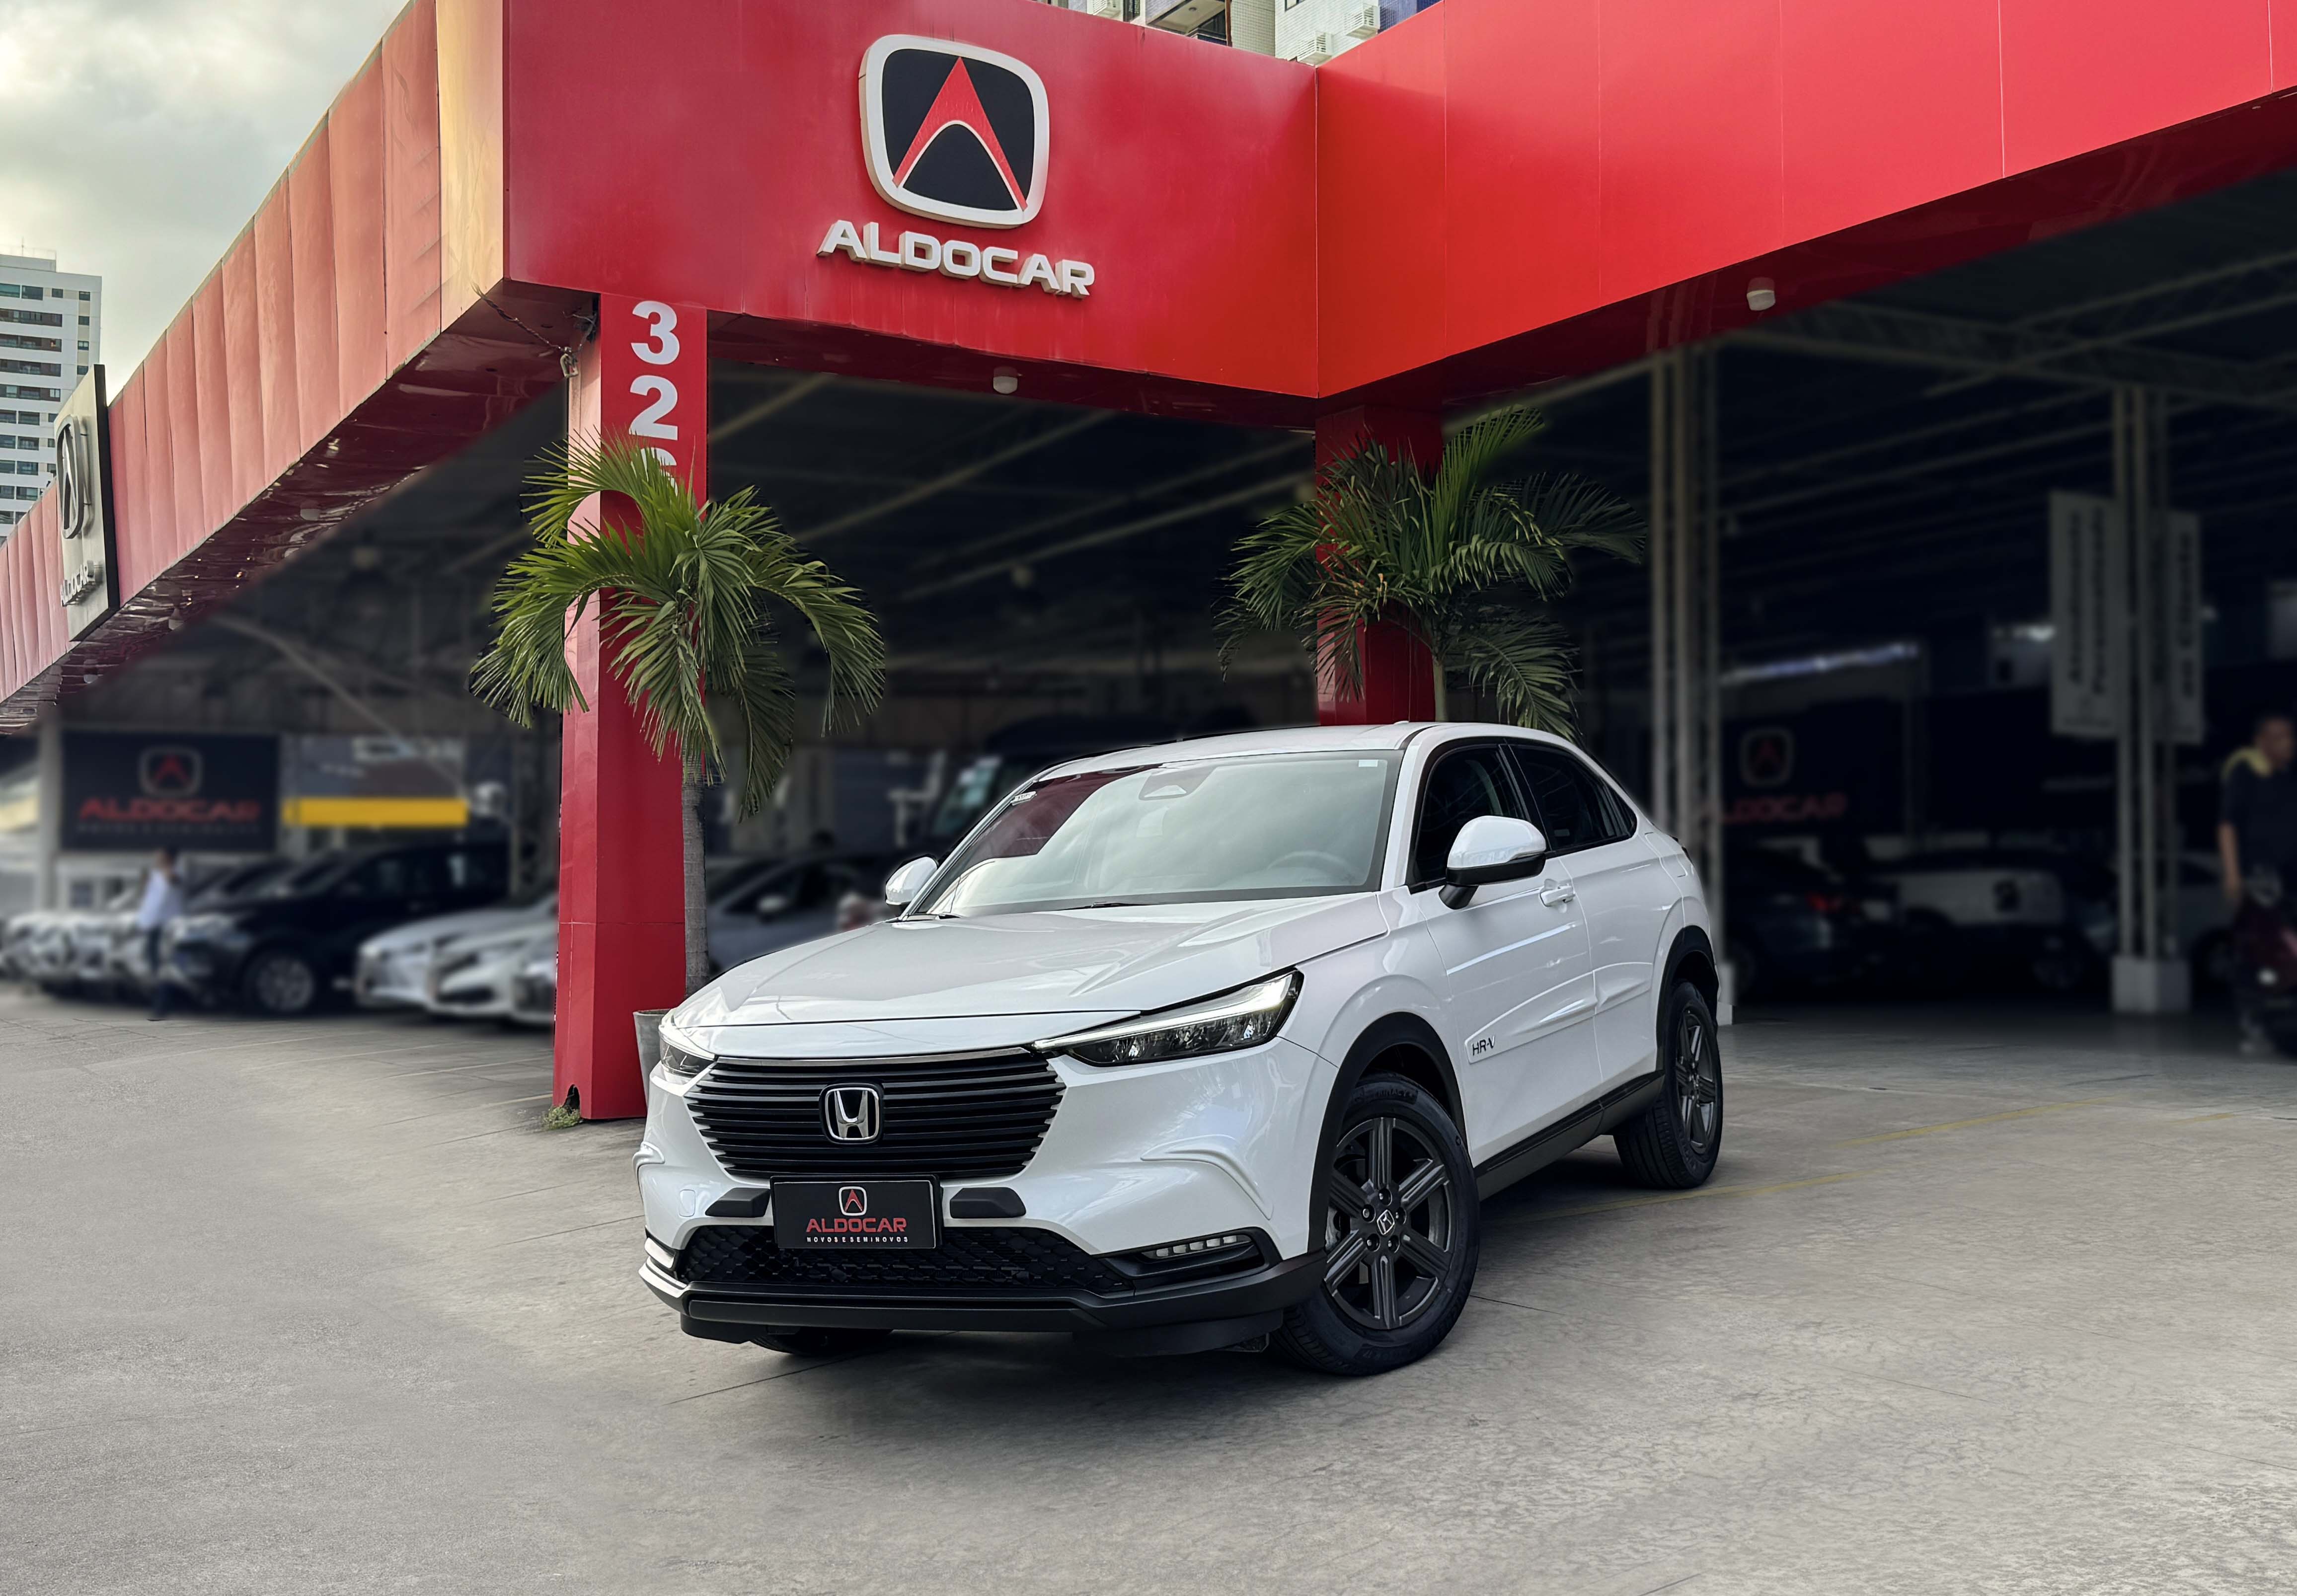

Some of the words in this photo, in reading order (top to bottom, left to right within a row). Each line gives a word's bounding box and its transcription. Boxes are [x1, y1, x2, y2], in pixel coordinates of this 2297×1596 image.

[816, 220, 1095, 299] ALDOCAR
[79, 797, 260, 822] ALDOCAR
[1472, 1035, 1495, 1056] HR-V
[806, 1217, 907, 1232] ALDOCAR
